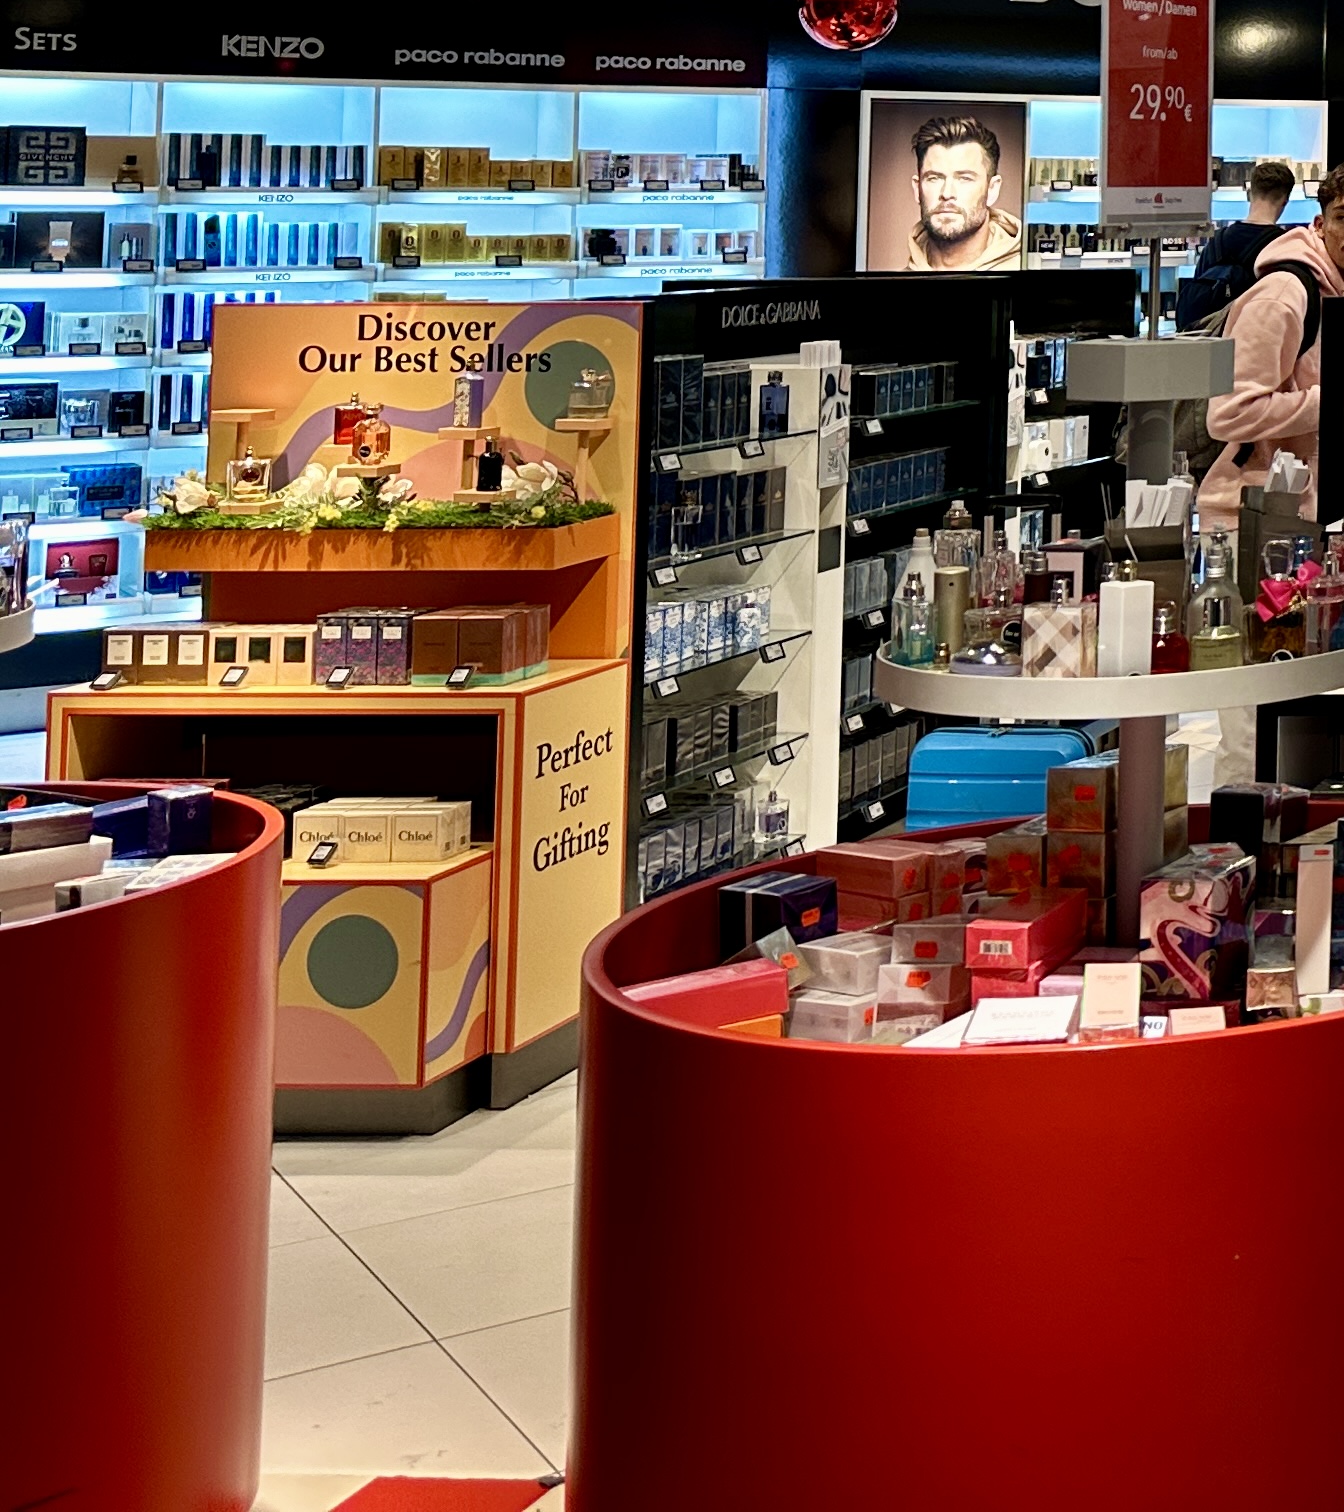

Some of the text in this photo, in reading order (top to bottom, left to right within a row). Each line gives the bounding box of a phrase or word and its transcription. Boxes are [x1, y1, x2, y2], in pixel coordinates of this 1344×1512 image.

[1165, 0, 1197, 17] Damen
[222, 34, 325, 60] KENZO
[395, 48, 566, 68] paco rabanne
[595, 54, 746, 73] paco rabanne
[19, 153, 75, 161] GIVENCHY
[357, 312, 496, 341] Discover
[298, 343, 552, 373] Our Best Sellers
[535, 726, 613, 779] Perfect
[558, 781, 589, 813] For
[348, 830, 383, 843] Chloé
[398, 829, 433, 842] Chloé
[533, 821, 610, 872] Gifting
